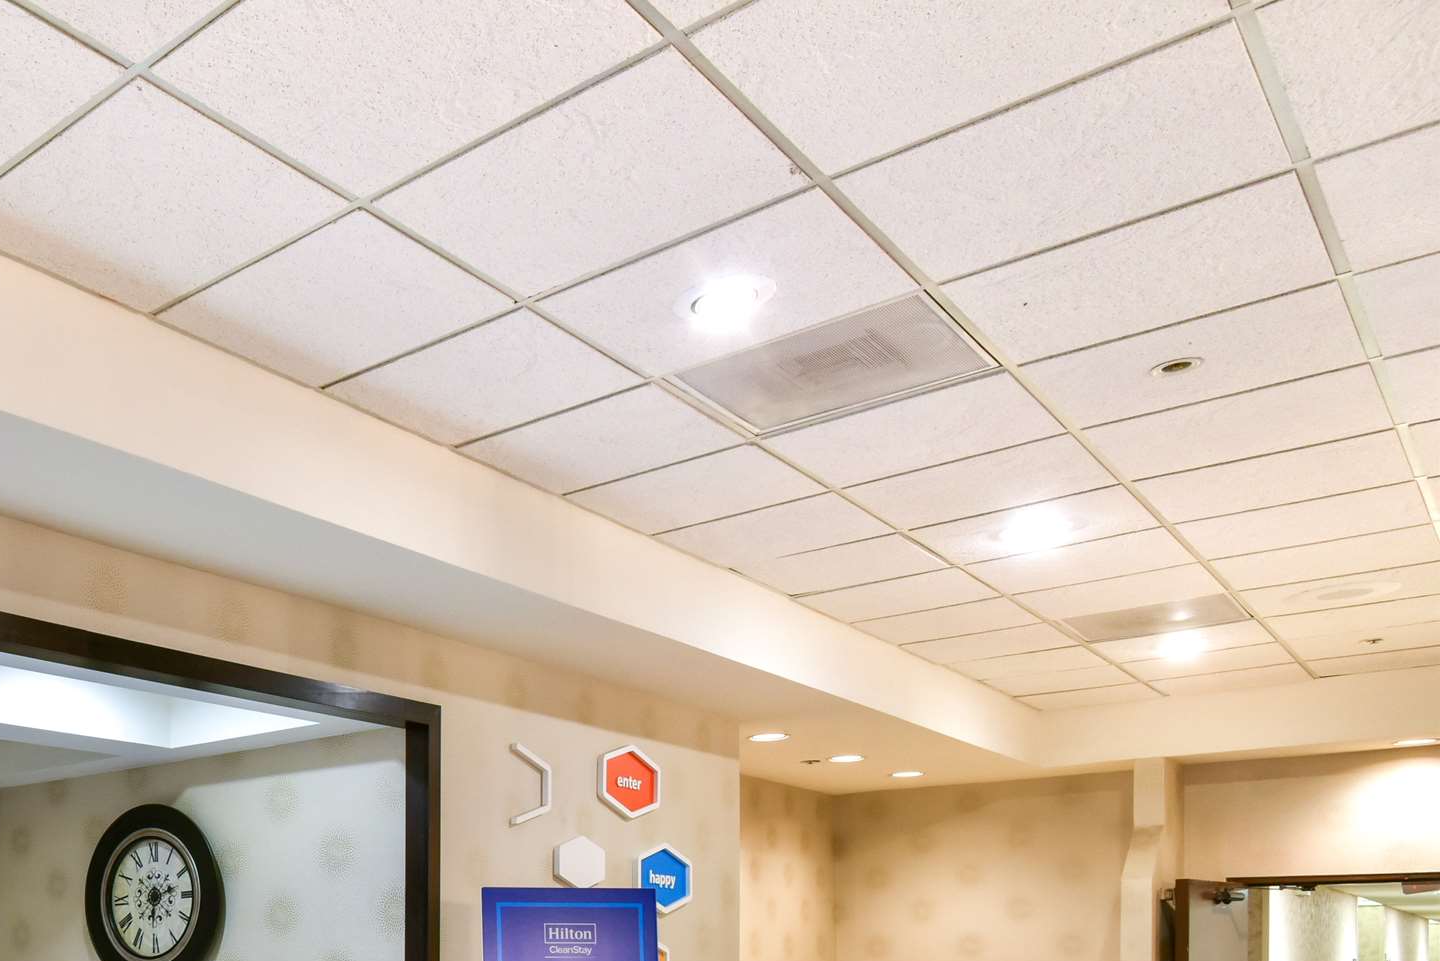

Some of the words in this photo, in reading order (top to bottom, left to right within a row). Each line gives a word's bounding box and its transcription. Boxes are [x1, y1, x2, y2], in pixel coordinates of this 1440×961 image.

[617, 776, 642, 790] enter
[649, 869, 676, 889] happy
[548, 927, 592, 940] Hilton
[549, 945, 593, 956] CleanStay
